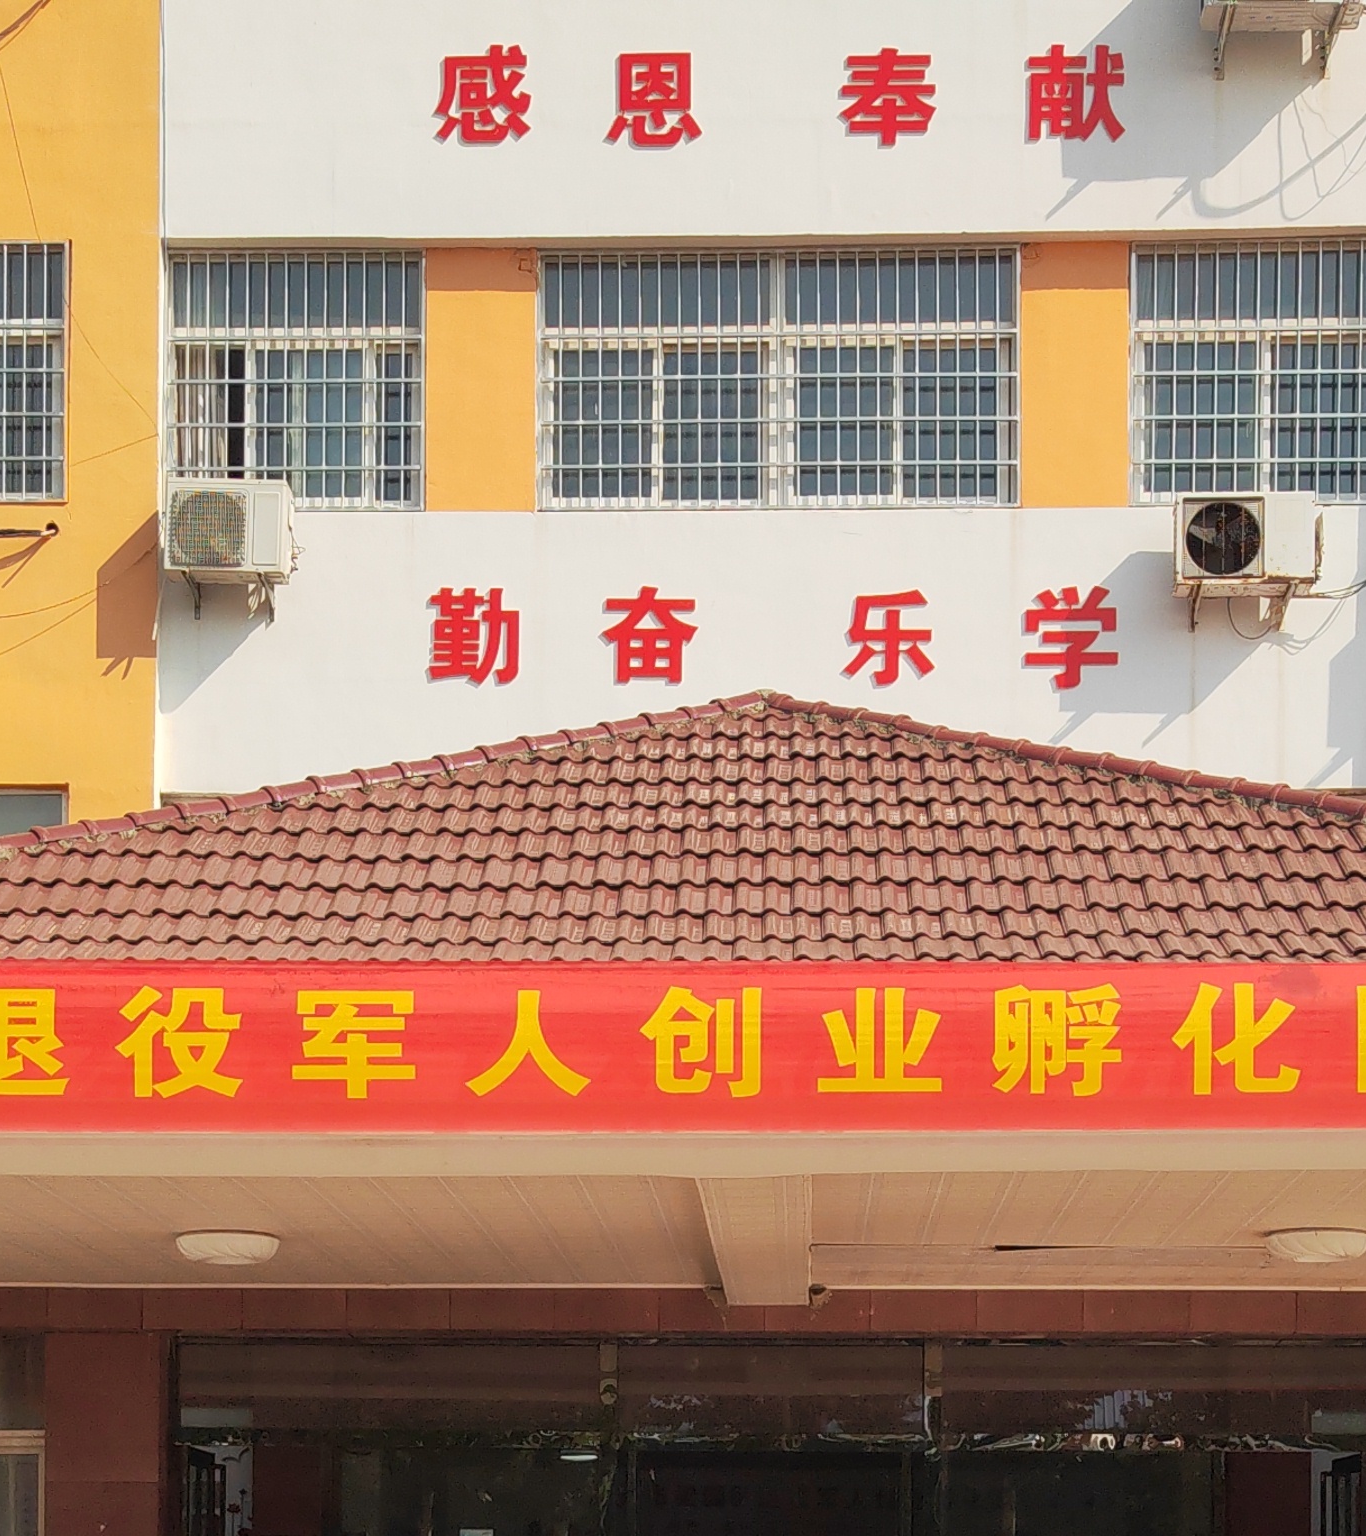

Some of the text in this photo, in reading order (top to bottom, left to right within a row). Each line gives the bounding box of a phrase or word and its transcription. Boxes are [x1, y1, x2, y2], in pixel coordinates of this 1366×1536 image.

[434, 44, 1125, 146] 感恩 奉献
[427, 586, 1119, 689] 勤奋 乐学
